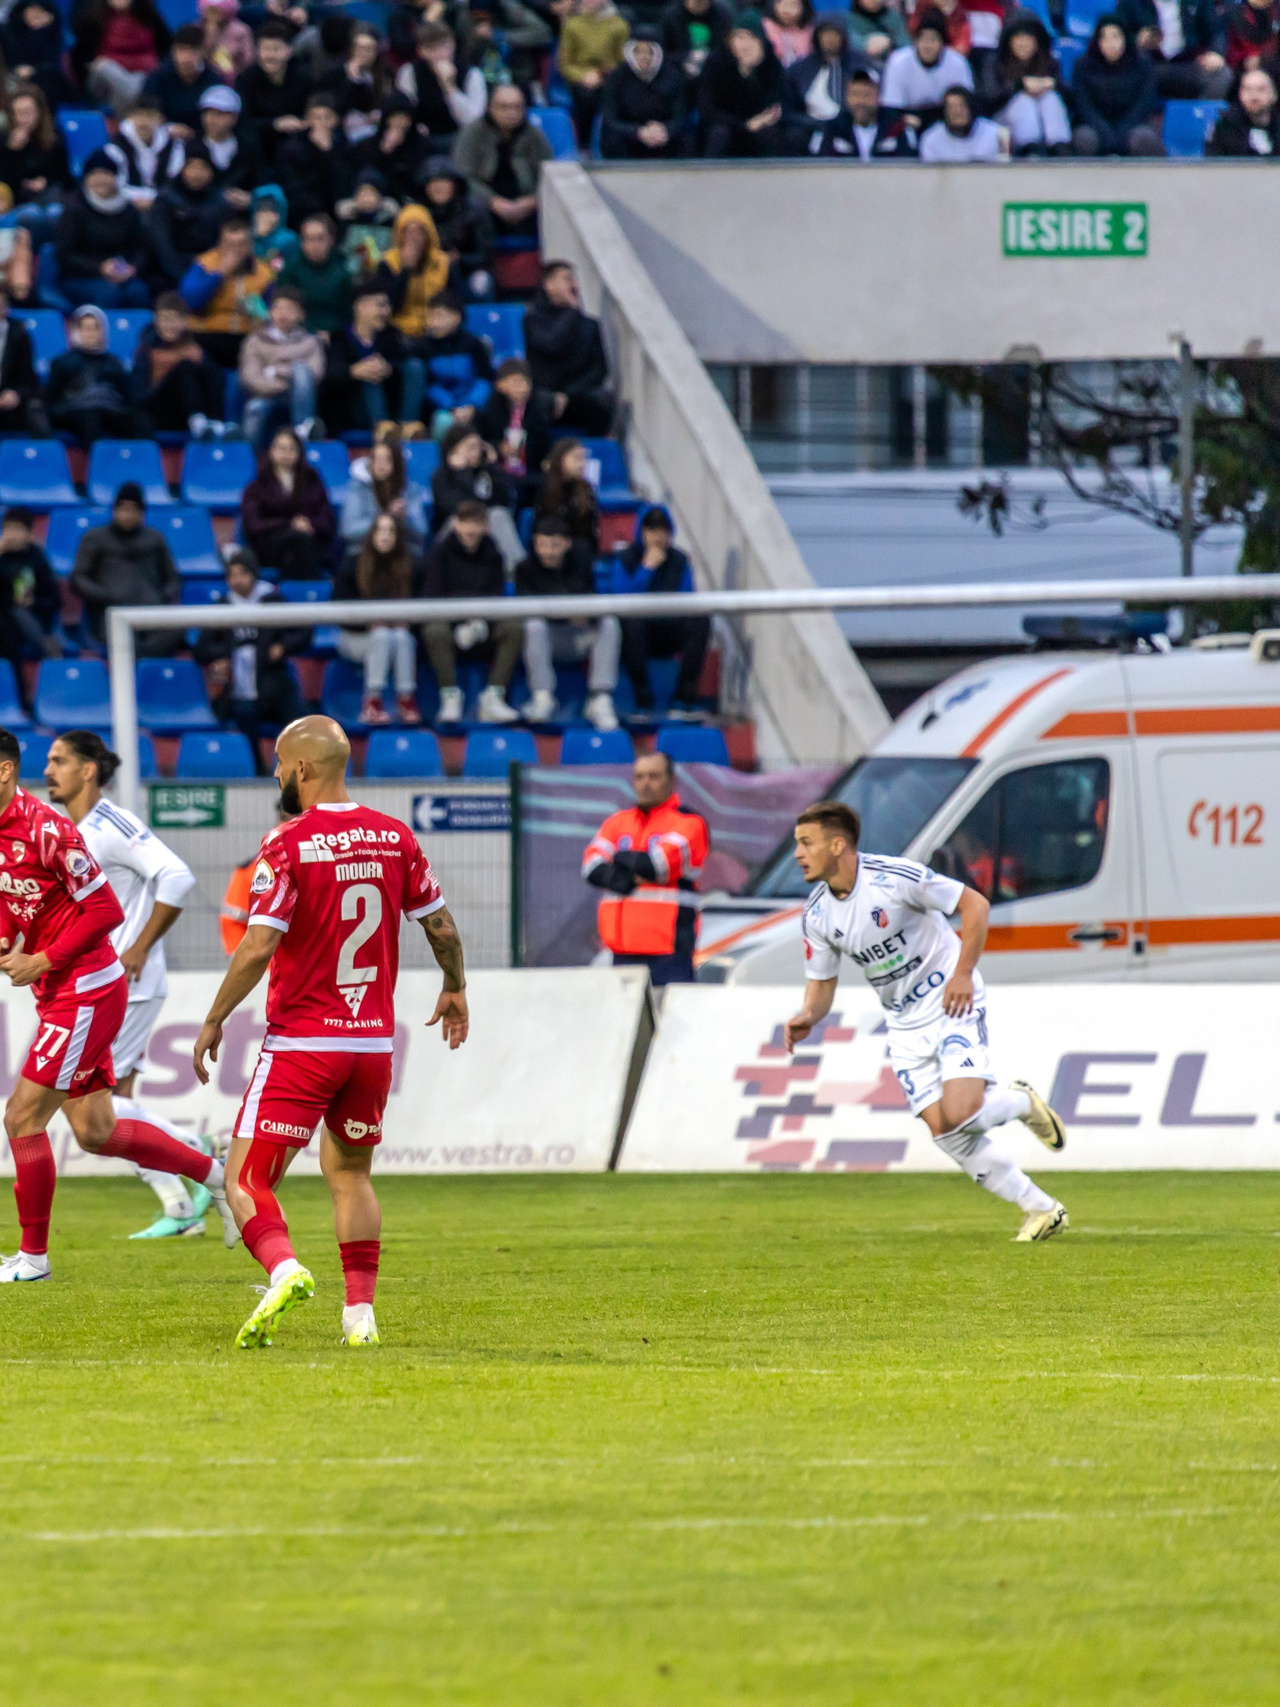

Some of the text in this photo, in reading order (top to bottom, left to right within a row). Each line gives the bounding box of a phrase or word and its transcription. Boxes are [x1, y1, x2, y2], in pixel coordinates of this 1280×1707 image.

[1007, 208, 1144, 251] IESIRE 2
[311, 826, 400, 851] Regata.ro
[1206, 803, 1265, 846] 112
[335, 861, 383, 882] MOURA
[336, 883, 382, 986] 2
[34, 1022, 70, 1057] 77
[324, 1018, 344, 1028] 7777
[1048, 1052, 1280, 1126] EL
